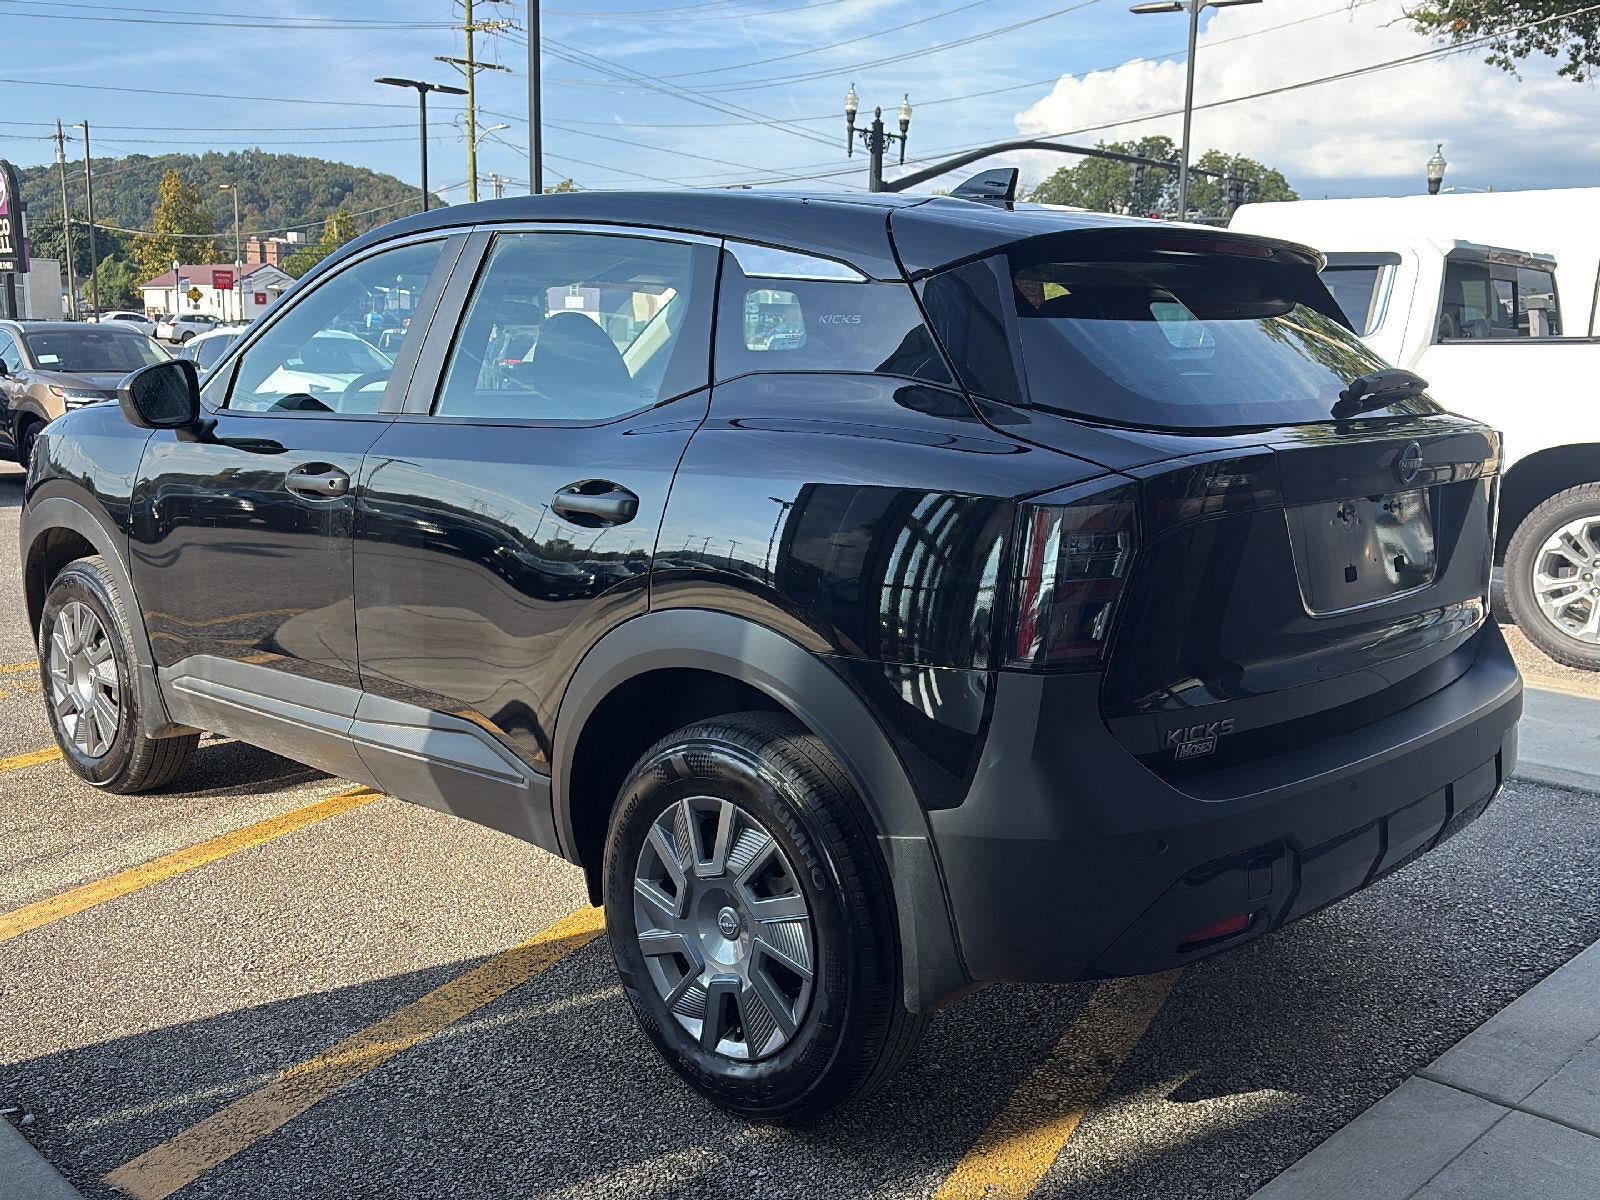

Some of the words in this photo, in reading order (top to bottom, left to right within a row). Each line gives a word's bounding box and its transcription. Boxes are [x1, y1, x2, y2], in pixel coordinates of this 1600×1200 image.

[819, 314, 862, 324] KICKS
[1166, 719, 1235, 745] KICKS
[760, 789, 826, 891] KUMHO
